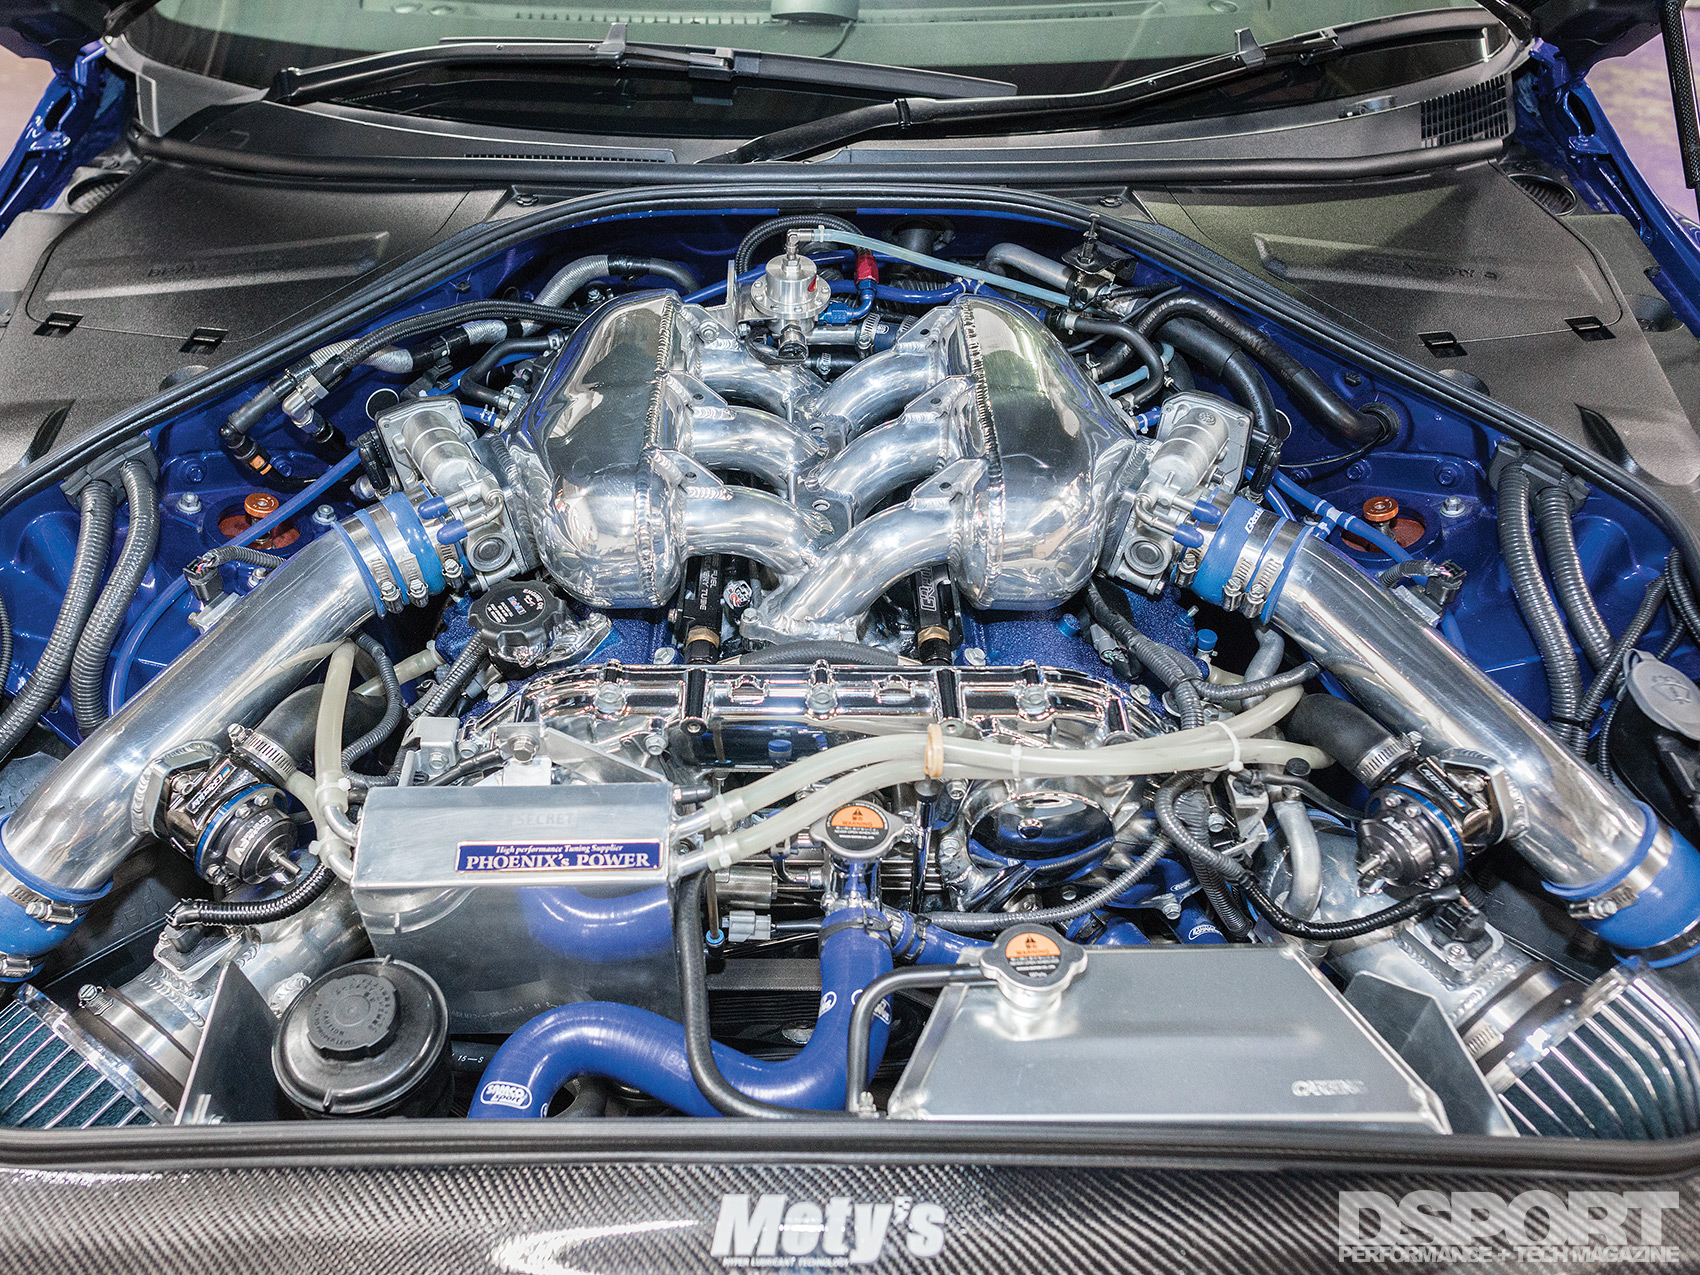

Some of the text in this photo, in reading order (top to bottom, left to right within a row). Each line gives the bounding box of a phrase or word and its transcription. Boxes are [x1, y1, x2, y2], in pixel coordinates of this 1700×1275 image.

[1245, 508, 1264, 534] GRedd
[710, 570, 718, 588] FUEL
[700, 588, 708, 611] TUBE
[517, 813, 573, 825] SECRET
[496, 843, 624, 855] High performance Tuning Supplier
[465, 852, 651, 870] PHOENIX's POWER
[323, 1010, 345, 1036] CAUTION
[485, 1084, 525, 1096] SAMCO
[494, 1094, 521, 1102] sport
[798, 1256, 849, 1267] TECHNOLOGY
